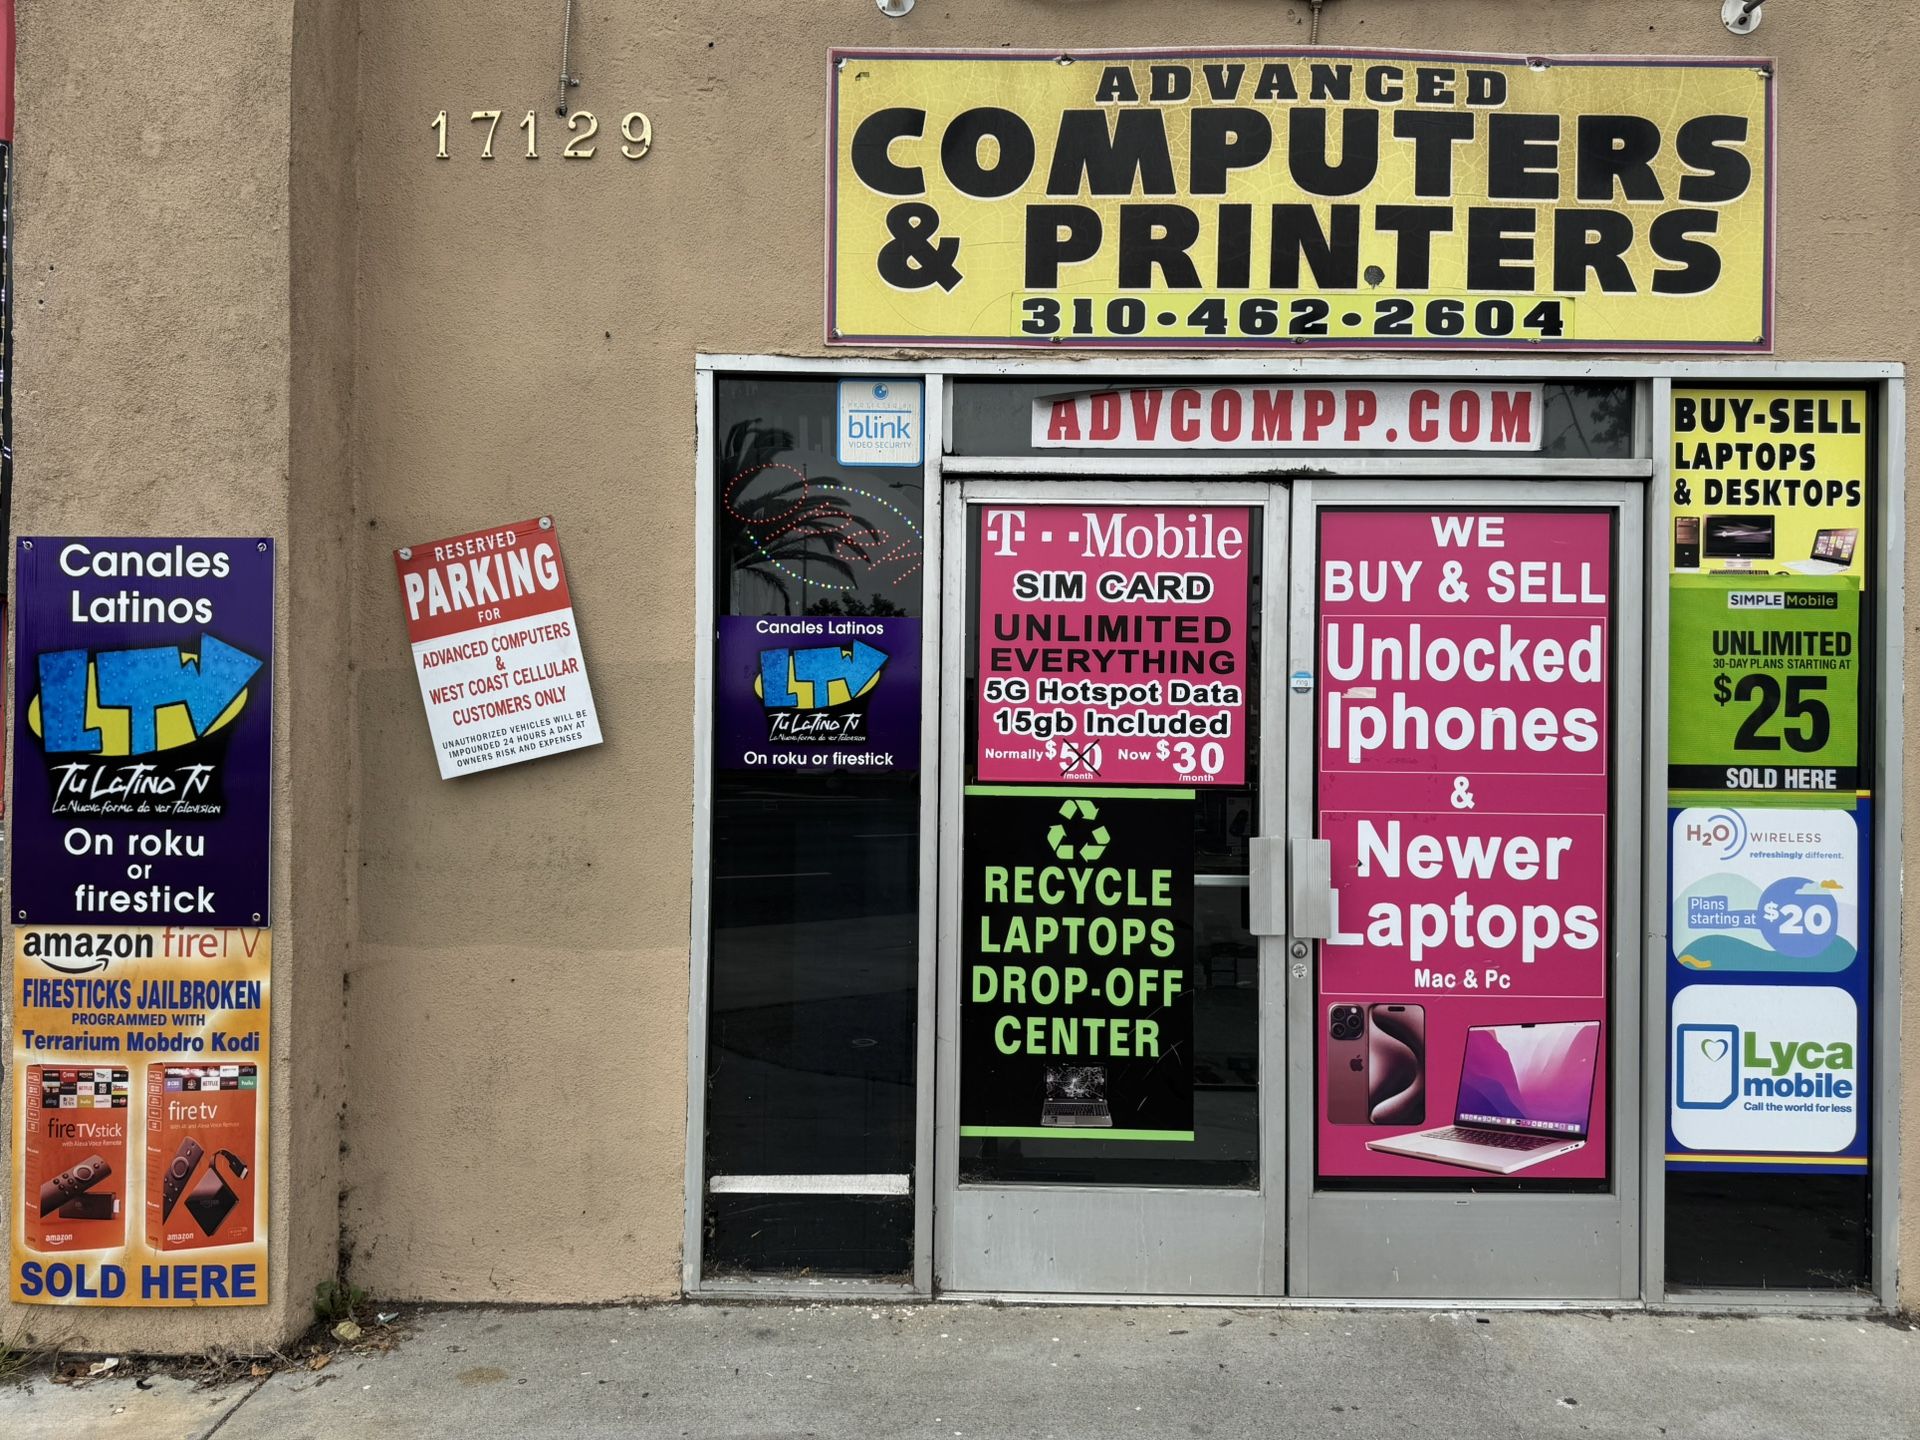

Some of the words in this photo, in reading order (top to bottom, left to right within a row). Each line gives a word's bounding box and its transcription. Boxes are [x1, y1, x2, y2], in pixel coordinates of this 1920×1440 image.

[1095, 63, 1507, 105] ADVANCED
[431, 110, 652, 159] 17129
[851, 106, 1752, 202] COMPUTERS
[876, 202, 964, 294] &
[1025, 203, 1722, 296] PRINTERS
[849, 415, 911, 439] blink
[1047, 388, 1532, 443] ADVCOMPP.COM
[1674, 397, 1861, 434] BUY-SELL
[849, 441, 873, 449] VIDEO
[875, 441, 912, 449] SECURITY
[1675, 442, 1816, 471] LAPTOPS
[1674, 478, 1692, 506] &
[1704, 479, 1861, 507] DESKTOPS
[434, 531, 517, 562] RESERVED
[1431, 516, 1505, 548] WE
[60, 543, 230, 578] Canales
[404, 543, 560, 621] PARKING
[1015, 571, 1086, 601] SIM
[1098, 573, 1213, 602] CARD
[1324, 560, 1423, 602] BUY
[1438, 560, 1470, 604] &
[1487, 561, 1606, 603] SELL
[71, 590, 213, 624] Latinos
[477, 607, 501, 622] FOR
[1730, 594, 1782, 606] SIMPLE
[1786, 594, 1835, 606] Mobile
[756, 620, 823, 635] Canales
[828, 620, 884, 636] Latinos
[994, 613, 1232, 644] UNLIMITED
[1712, 630, 1852, 657] UNLIMITED
[422, 640, 489, 669] ADVANCED
[491, 621, 571, 653] COMPUTERS
[1327, 623, 1602, 683] Unlocked
[495, 655, 506, 671] &
[990, 648, 1236, 675] EVERYTHING
[1712, 658, 1748, 669] 30-DAY
[1750, 658, 1784, 669] PLANS
[1787, 659, 1837, 670] STARTING
[1838, 660, 1851, 670] AT
[429, 683, 464, 705] WEST
[468, 673, 509, 697] COAST
[513, 657, 580, 686] CELLULAR
[985, 679, 1028, 702] 5G
[1036, 679, 1161, 709] Hotspot
[1168, 681, 1242, 706] Data
[452, 695, 532, 726] CUSTOMERS
[535, 685, 568, 708] ONLY
[1713, 672, 1830, 753] $25
[442, 728, 508, 750] UNAUTHORIZED
[509, 717, 551, 735] VEHICLES
[552, 713, 574, 725] WILL
[575, 709, 588, 719] BE
[768, 712, 791, 737] Tu
[993, 708, 1077, 739] 15gb
[1085, 709, 1231, 738] Included
[1327, 691, 1600, 764] Iphones
[448, 740, 500, 759] IMPOUNDED
[503, 735, 515, 746] 24
[516, 728, 548, 743] HOURS
[549, 727, 556, 735] A
[557, 723, 574, 734] DAY
[576, 720, 586, 730] AT
[456, 752, 494, 768] OWNERS
[496, 746, 517, 759] RISK
[518, 742, 537, 755] AND
[538, 731, 583, 749] EXPENSES
[743, 751, 768, 765] On
[772, 751, 807, 765] roku
[812, 754, 828, 765] or
[832, 751, 894, 766] firestick
[985, 748, 1043, 762] Normally
[1117, 748, 1152, 761] Now
[1156, 739, 1225, 775] $30
[50, 761, 91, 801] Tu
[1063, 772, 1094, 781] /month
[1178, 773, 1215, 783] /month
[1449, 776, 1476, 809] &
[1726, 767, 1777, 789] SOLD
[1784, 768, 1837, 790] HERE
[52, 800, 66, 813] La
[67, 800, 101, 813] Nueva
[100, 800, 134, 815] forma
[137, 800, 150, 813] de
[154, 804, 171, 813] ver
[64, 827, 114, 856] On
[128, 829, 205, 856] roku
[1357, 819, 1573, 881] Newer
[1750, 832, 1822, 843] WIRELESS
[127, 864, 152, 879] or
[1750, 851, 1803, 861] refreshingly
[1805, 851, 1844, 860] different.
[75, 884, 216, 913] firestick
[985, 865, 1172, 906] RECYCLE
[1326, 888, 1600, 963] Laptops
[1690, 912, 1740, 926] starting
[1742, 913, 1757, 926] at
[1691, 897, 1725, 911] Plans
[1763, 901, 1832, 936] $20
[23, 932, 154, 959] amazon
[980, 916, 1175, 957] LAPTOPS
[22, 978, 131, 1009] FIRESTICKS
[136, 980, 262, 1010] JAILBROKEN
[972, 965, 1183, 1007] DROP-OFF
[1414, 968, 1456, 989] Mac
[1463, 969, 1479, 990] &
[1485, 969, 1511, 990] Pc
[71, 1013, 167, 1026] PROGRAMMED
[172, 1014, 206, 1027] WITH
[22, 1029, 120, 1051] Terrarium
[127, 1031, 204, 1052] Mobdro
[211, 1031, 260, 1052] Kodi
[994, 1015, 1160, 1058] CENTER
[1744, 1031, 1854, 1077] Lyca
[1744, 1072, 1853, 1099] mobile
[1743, 1102, 1765, 1112] Call
[1766, 1102, 1783, 1112] the
[1784, 1103, 1814, 1112] world
[1815, 1103, 1830, 1113] for
[1831, 1104, 1852, 1113] less
[45, 1233, 73, 1242] amazon
[166, 1232, 194, 1242] amazon
[20, 1261, 127, 1298] SOLD
[141, 1263, 256, 1299] HERE
